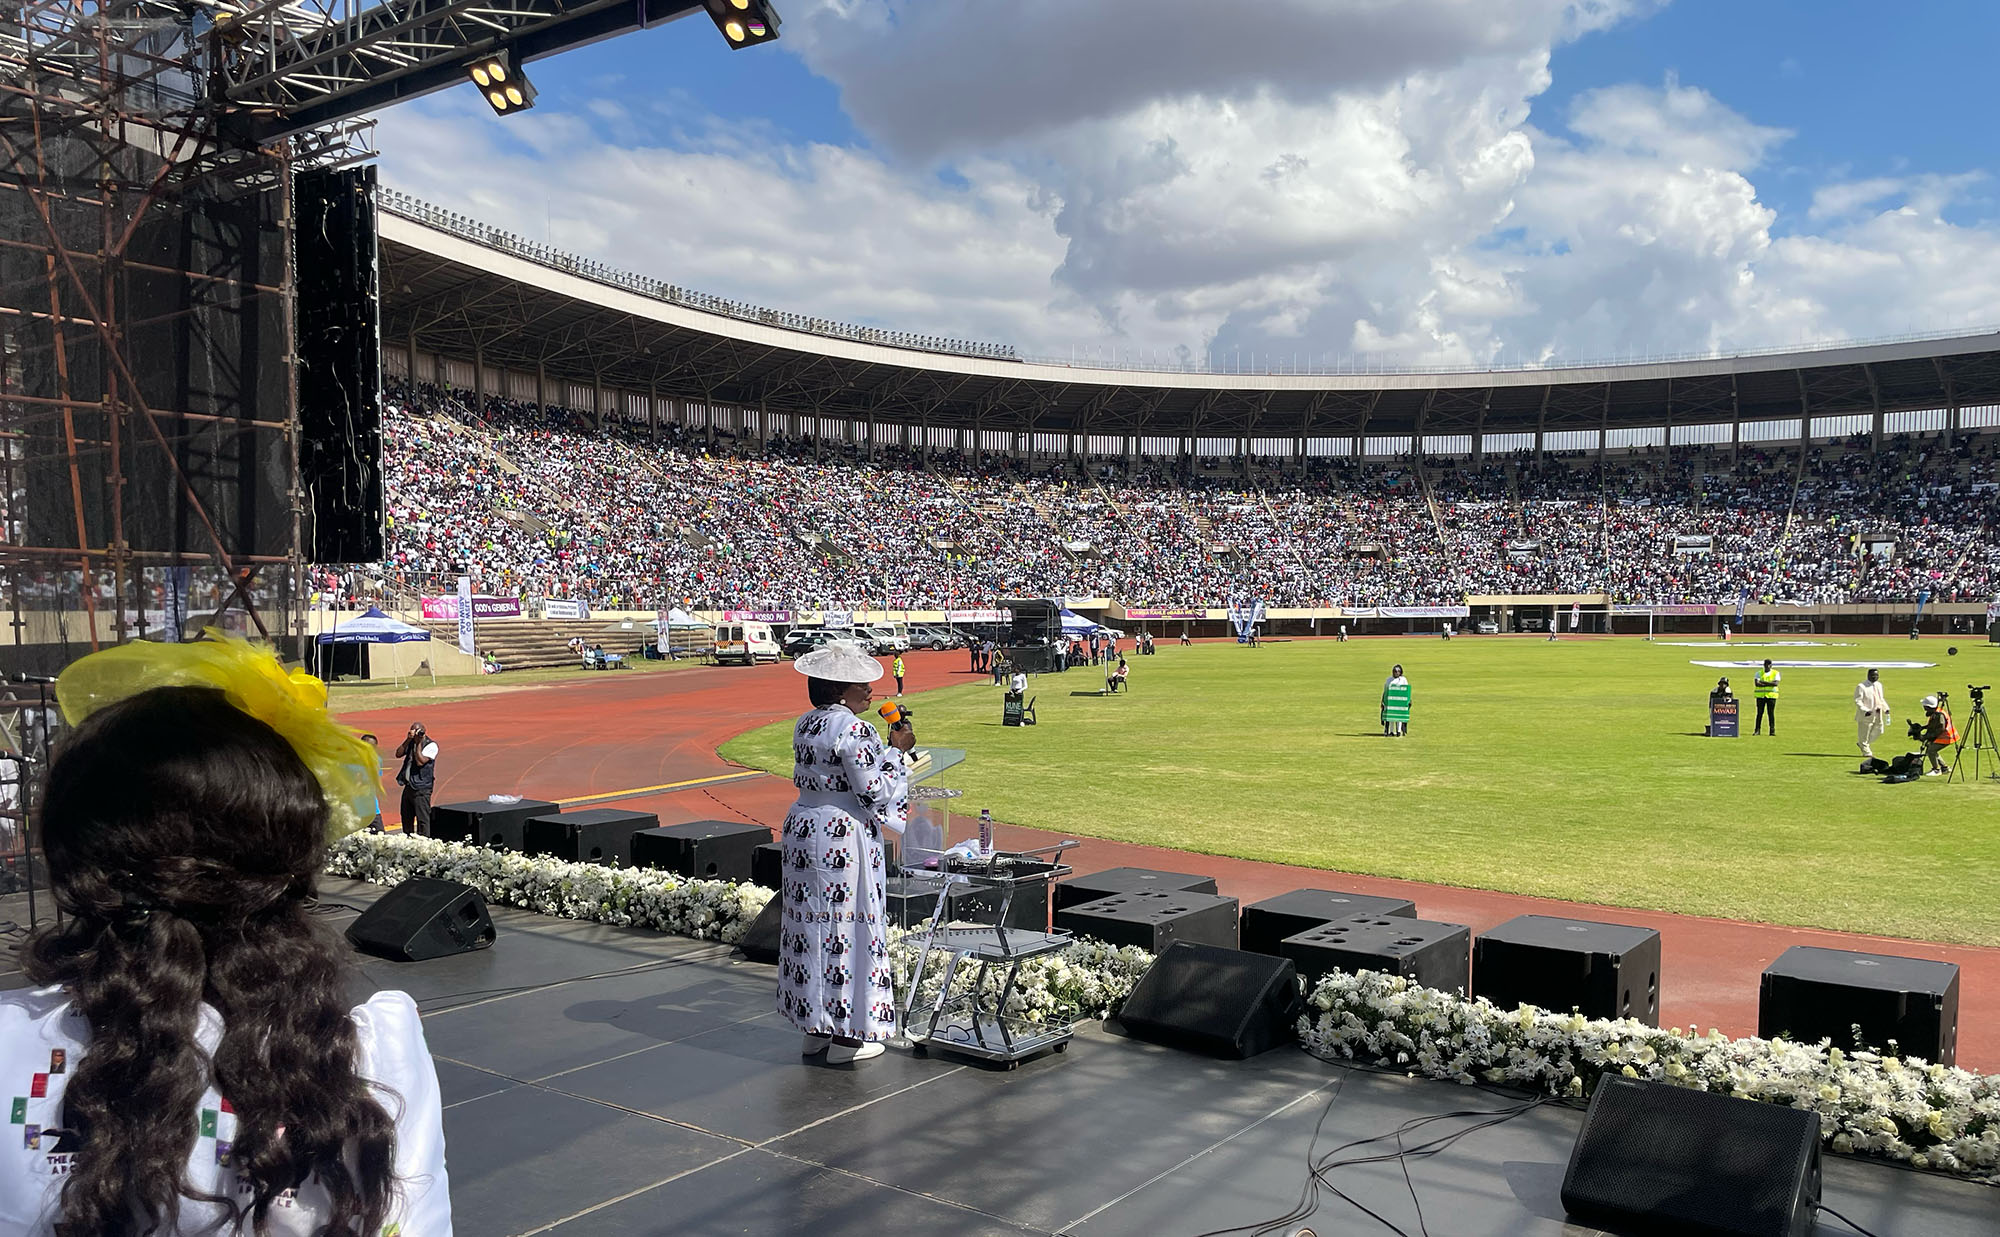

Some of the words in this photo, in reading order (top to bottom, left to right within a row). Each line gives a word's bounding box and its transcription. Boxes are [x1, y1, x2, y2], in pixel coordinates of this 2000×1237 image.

[492, 602, 518, 613] GENERAL
[754, 613, 774, 621] NOSSO
[46, 1155, 67, 1164] THE
